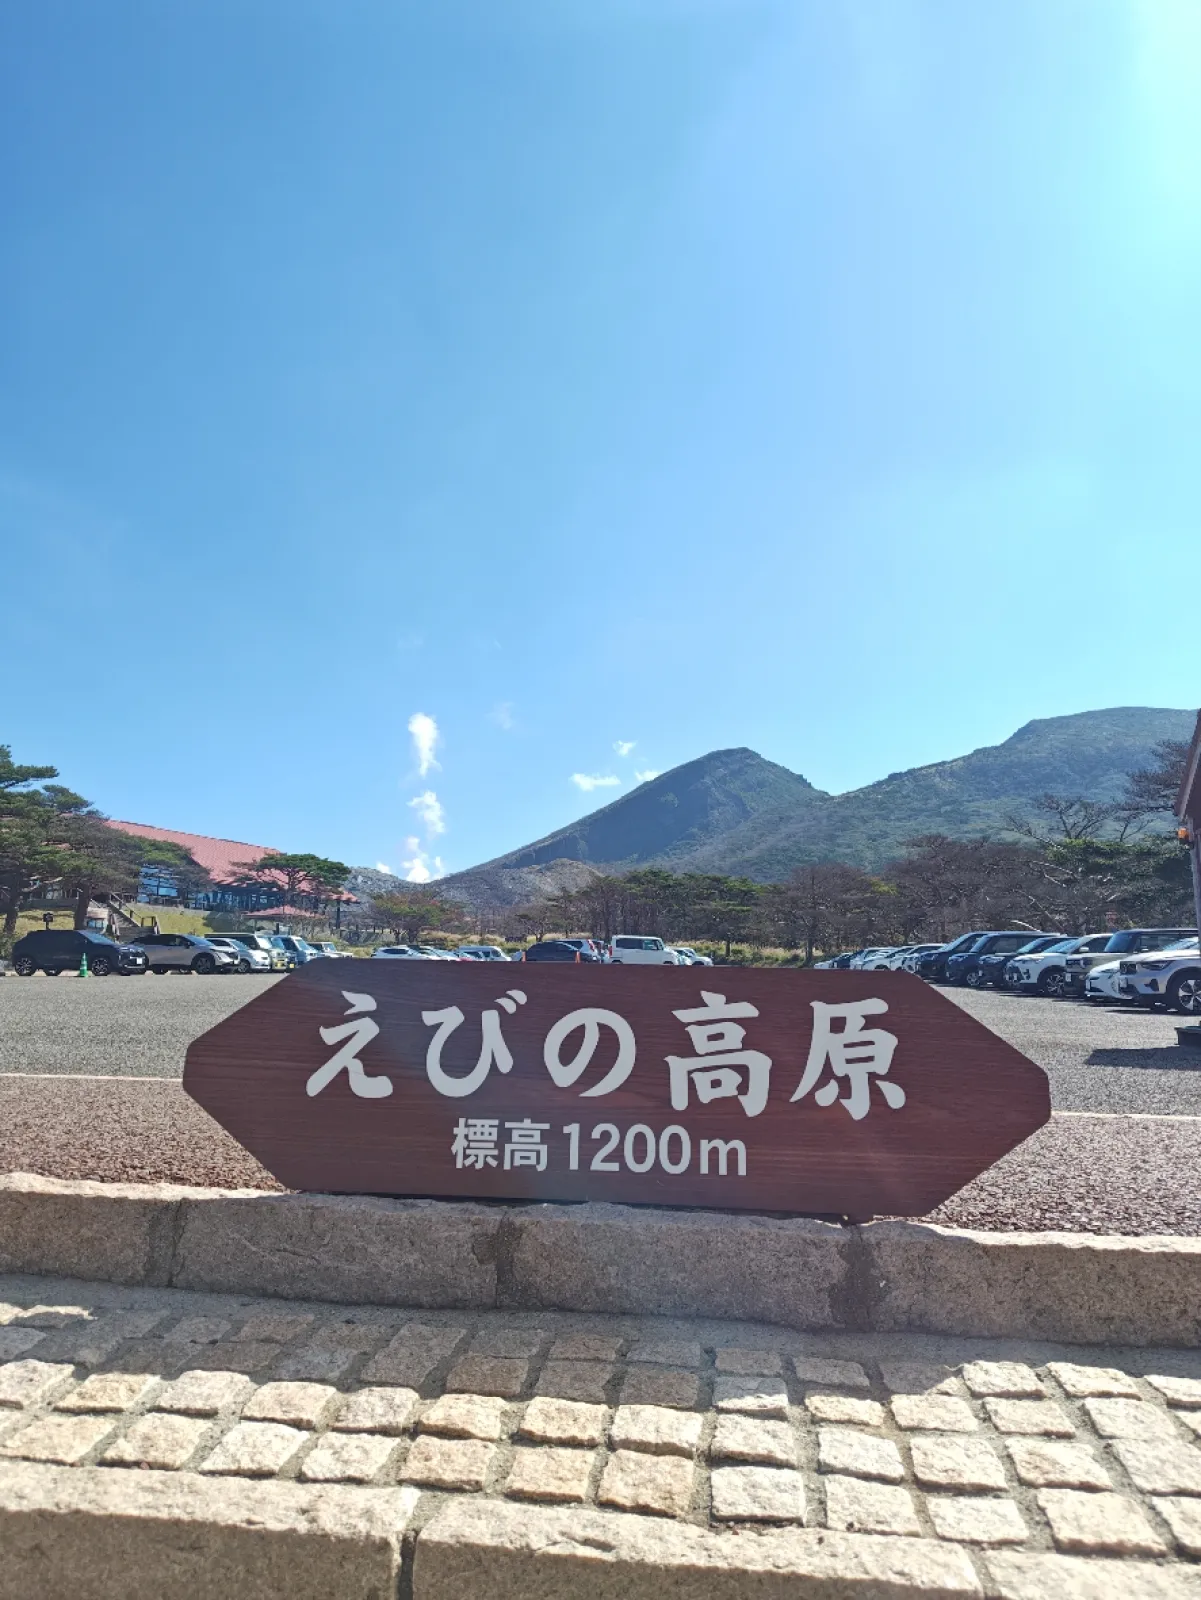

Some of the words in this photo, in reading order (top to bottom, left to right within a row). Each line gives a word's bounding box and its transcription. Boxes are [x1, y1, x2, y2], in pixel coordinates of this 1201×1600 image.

[306, 989, 906, 1121] えびの高原
[450, 1117, 748, 1177] 標高1200m
